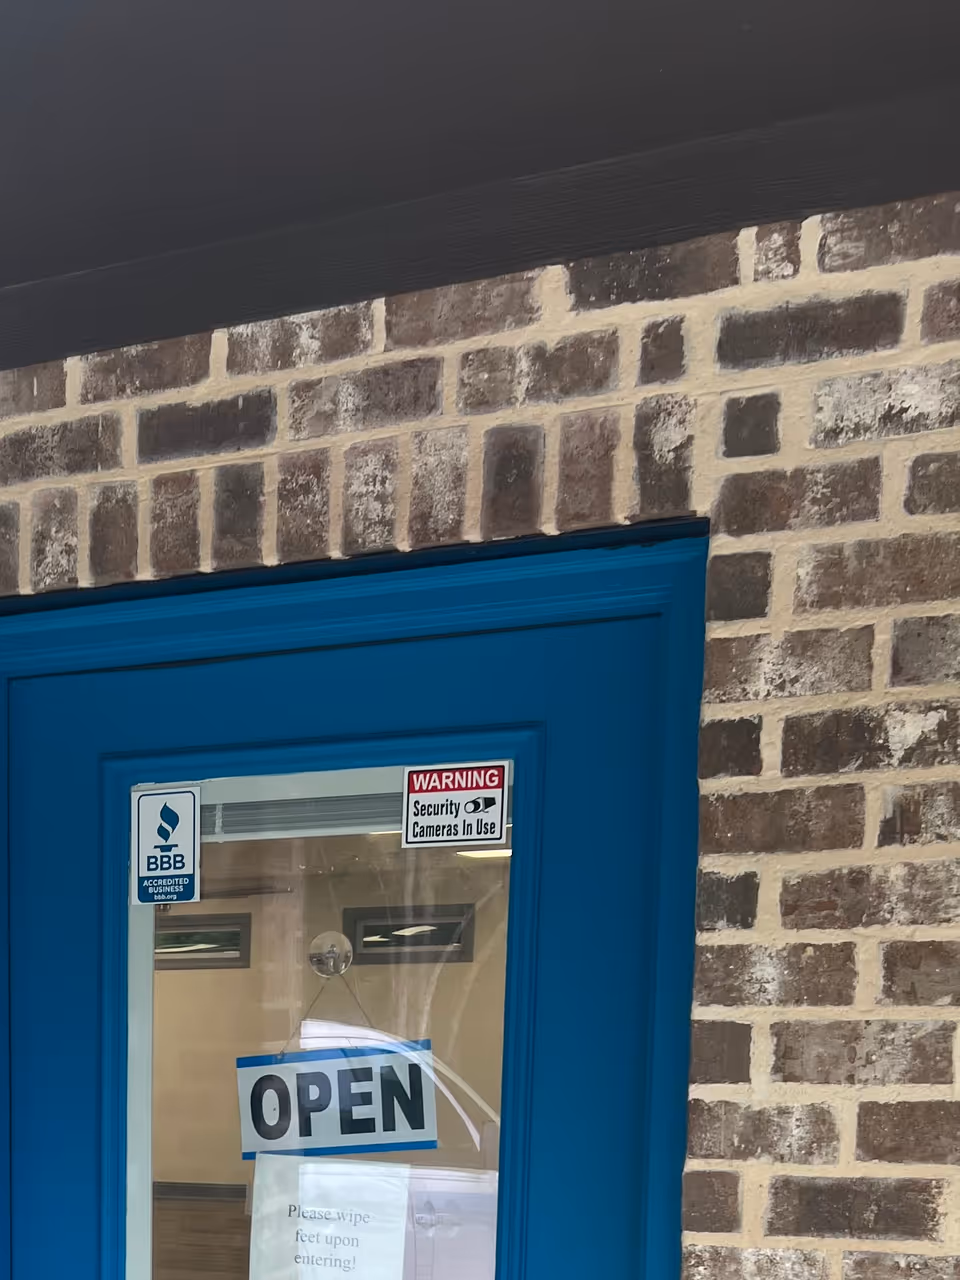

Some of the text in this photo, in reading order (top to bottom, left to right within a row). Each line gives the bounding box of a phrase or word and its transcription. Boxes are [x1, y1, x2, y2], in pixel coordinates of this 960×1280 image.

[412, 769, 499, 791] WARNING
[413, 799, 461, 818] Security
[412, 818, 496, 838] Cameras In Use
[146, 853, 186, 872] BBB
[143, 878, 189, 887] ACCREDITED
[148, 885, 184, 894] BUSINESS
[250, 1063, 426, 1140] OPEN
[288, 1204, 370, 1226] Please wipe
[295, 1228, 360, 1249] feet upon
[294, 1254, 356, 1272] entering!
